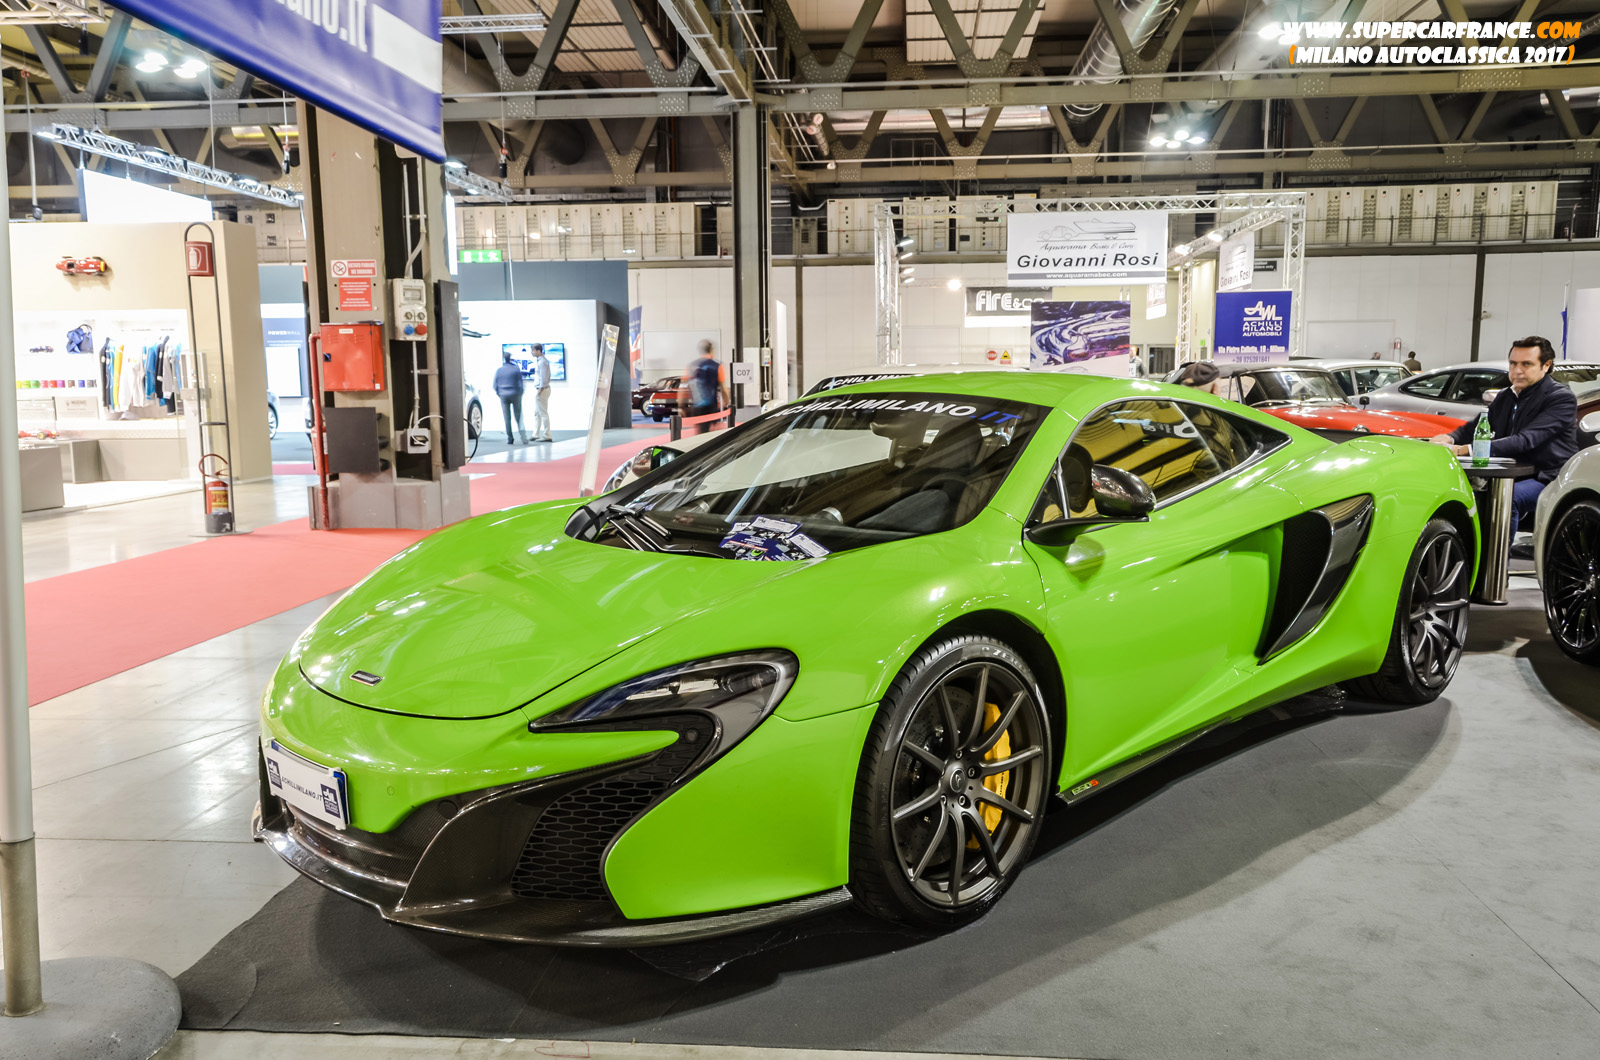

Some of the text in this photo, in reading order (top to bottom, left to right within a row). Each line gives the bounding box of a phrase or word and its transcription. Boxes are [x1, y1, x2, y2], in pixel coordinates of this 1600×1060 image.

[1017, 252, 1159, 268] Giovanni Rosi
[1046, 271, 1128, 279] www.aquaramabec.com
